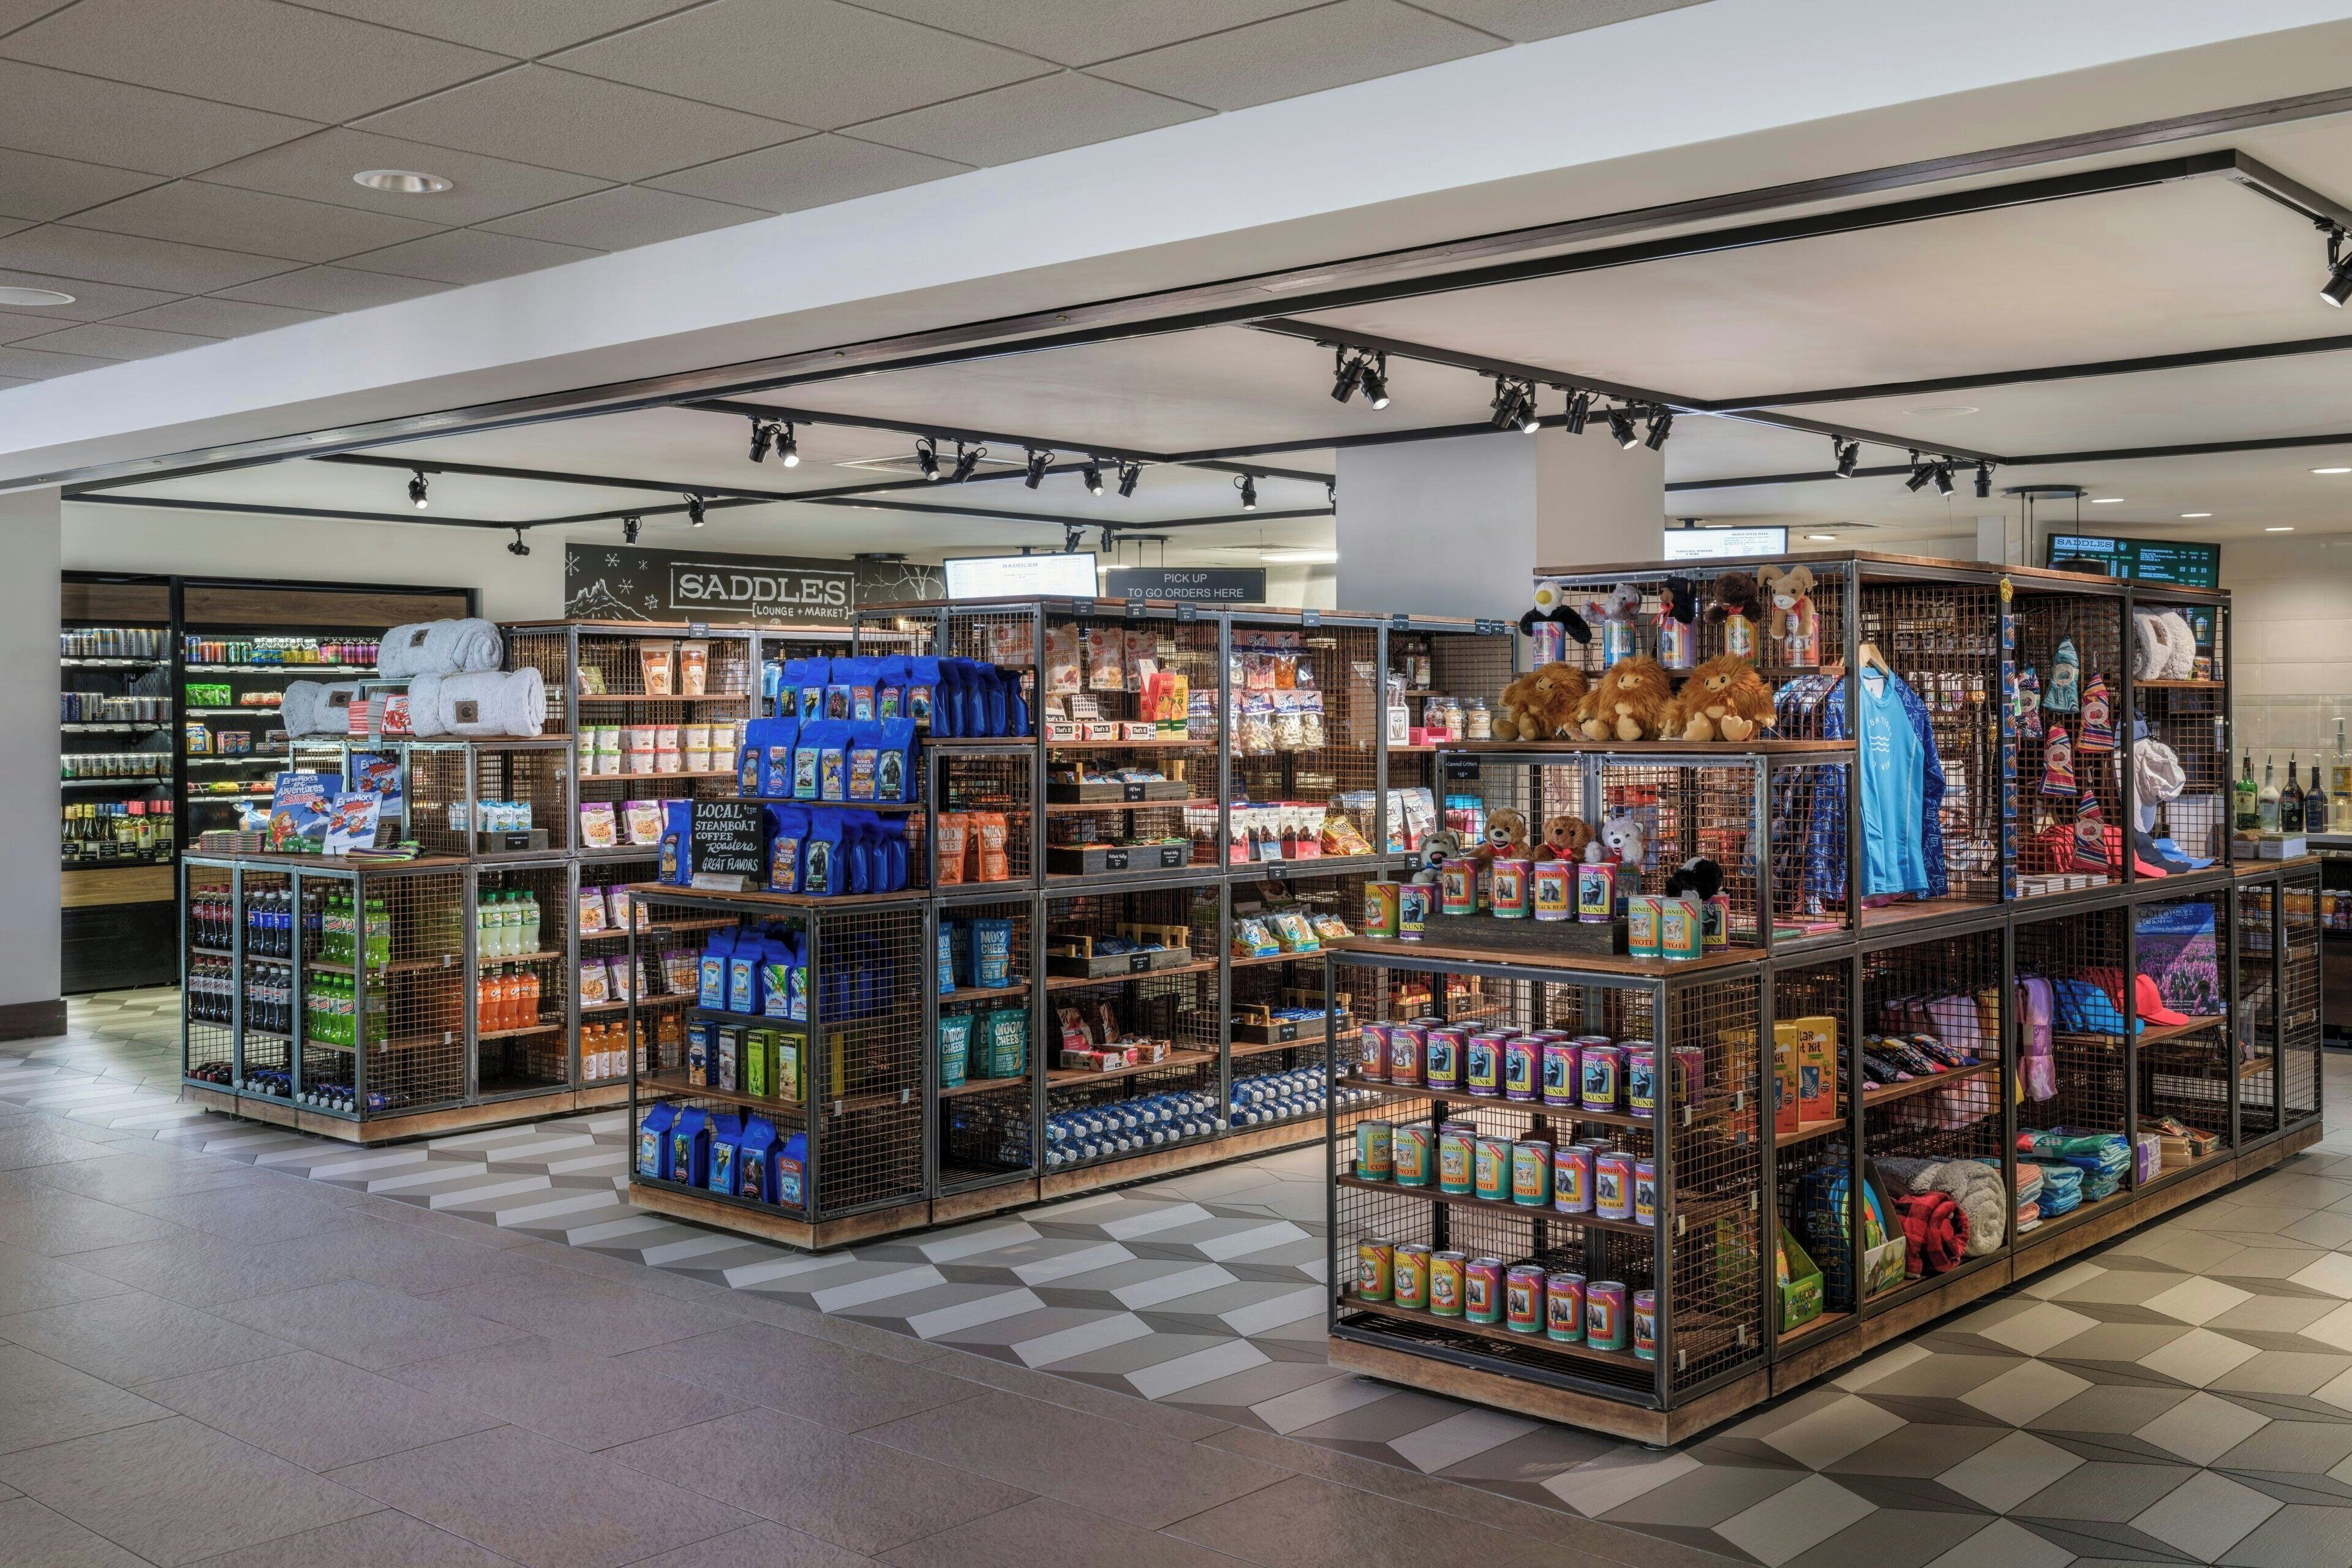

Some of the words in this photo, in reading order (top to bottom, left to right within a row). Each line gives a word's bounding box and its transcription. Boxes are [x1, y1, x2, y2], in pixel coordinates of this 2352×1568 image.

[2057, 538, 2113, 548] SADDLES
[1164, 573, 1189, 582] PICK
[1193, 573, 1207, 582] UP
[679, 573, 845, 605] SADDLES
[1128, 588, 1142, 598] TO
[1145, 588, 1163, 598] GO
[1165, 588, 1211, 598] ORDERS
[1214, 588, 1244, 598] HERE
[696, 804, 742, 818] LOCAL
[695, 820, 756, 831] STEAMBOAT
[696, 832, 733, 841] COFFEE
[706, 839, 756, 853] Roasters
[703, 858, 726, 872] GREAT
[727, 858, 758, 872] FLAVORS
[2139, 909, 2204, 918] COLORADO
[981, 930, 1007, 944] MOON
[942, 1028, 967, 1043] MOON
[995, 1022, 1024, 1036] MOON
[996, 1035, 1022, 1047] CHEESE
[1808, 1042, 1821, 1053] Kit
[942, 1041, 965, 1055] CHEESE
